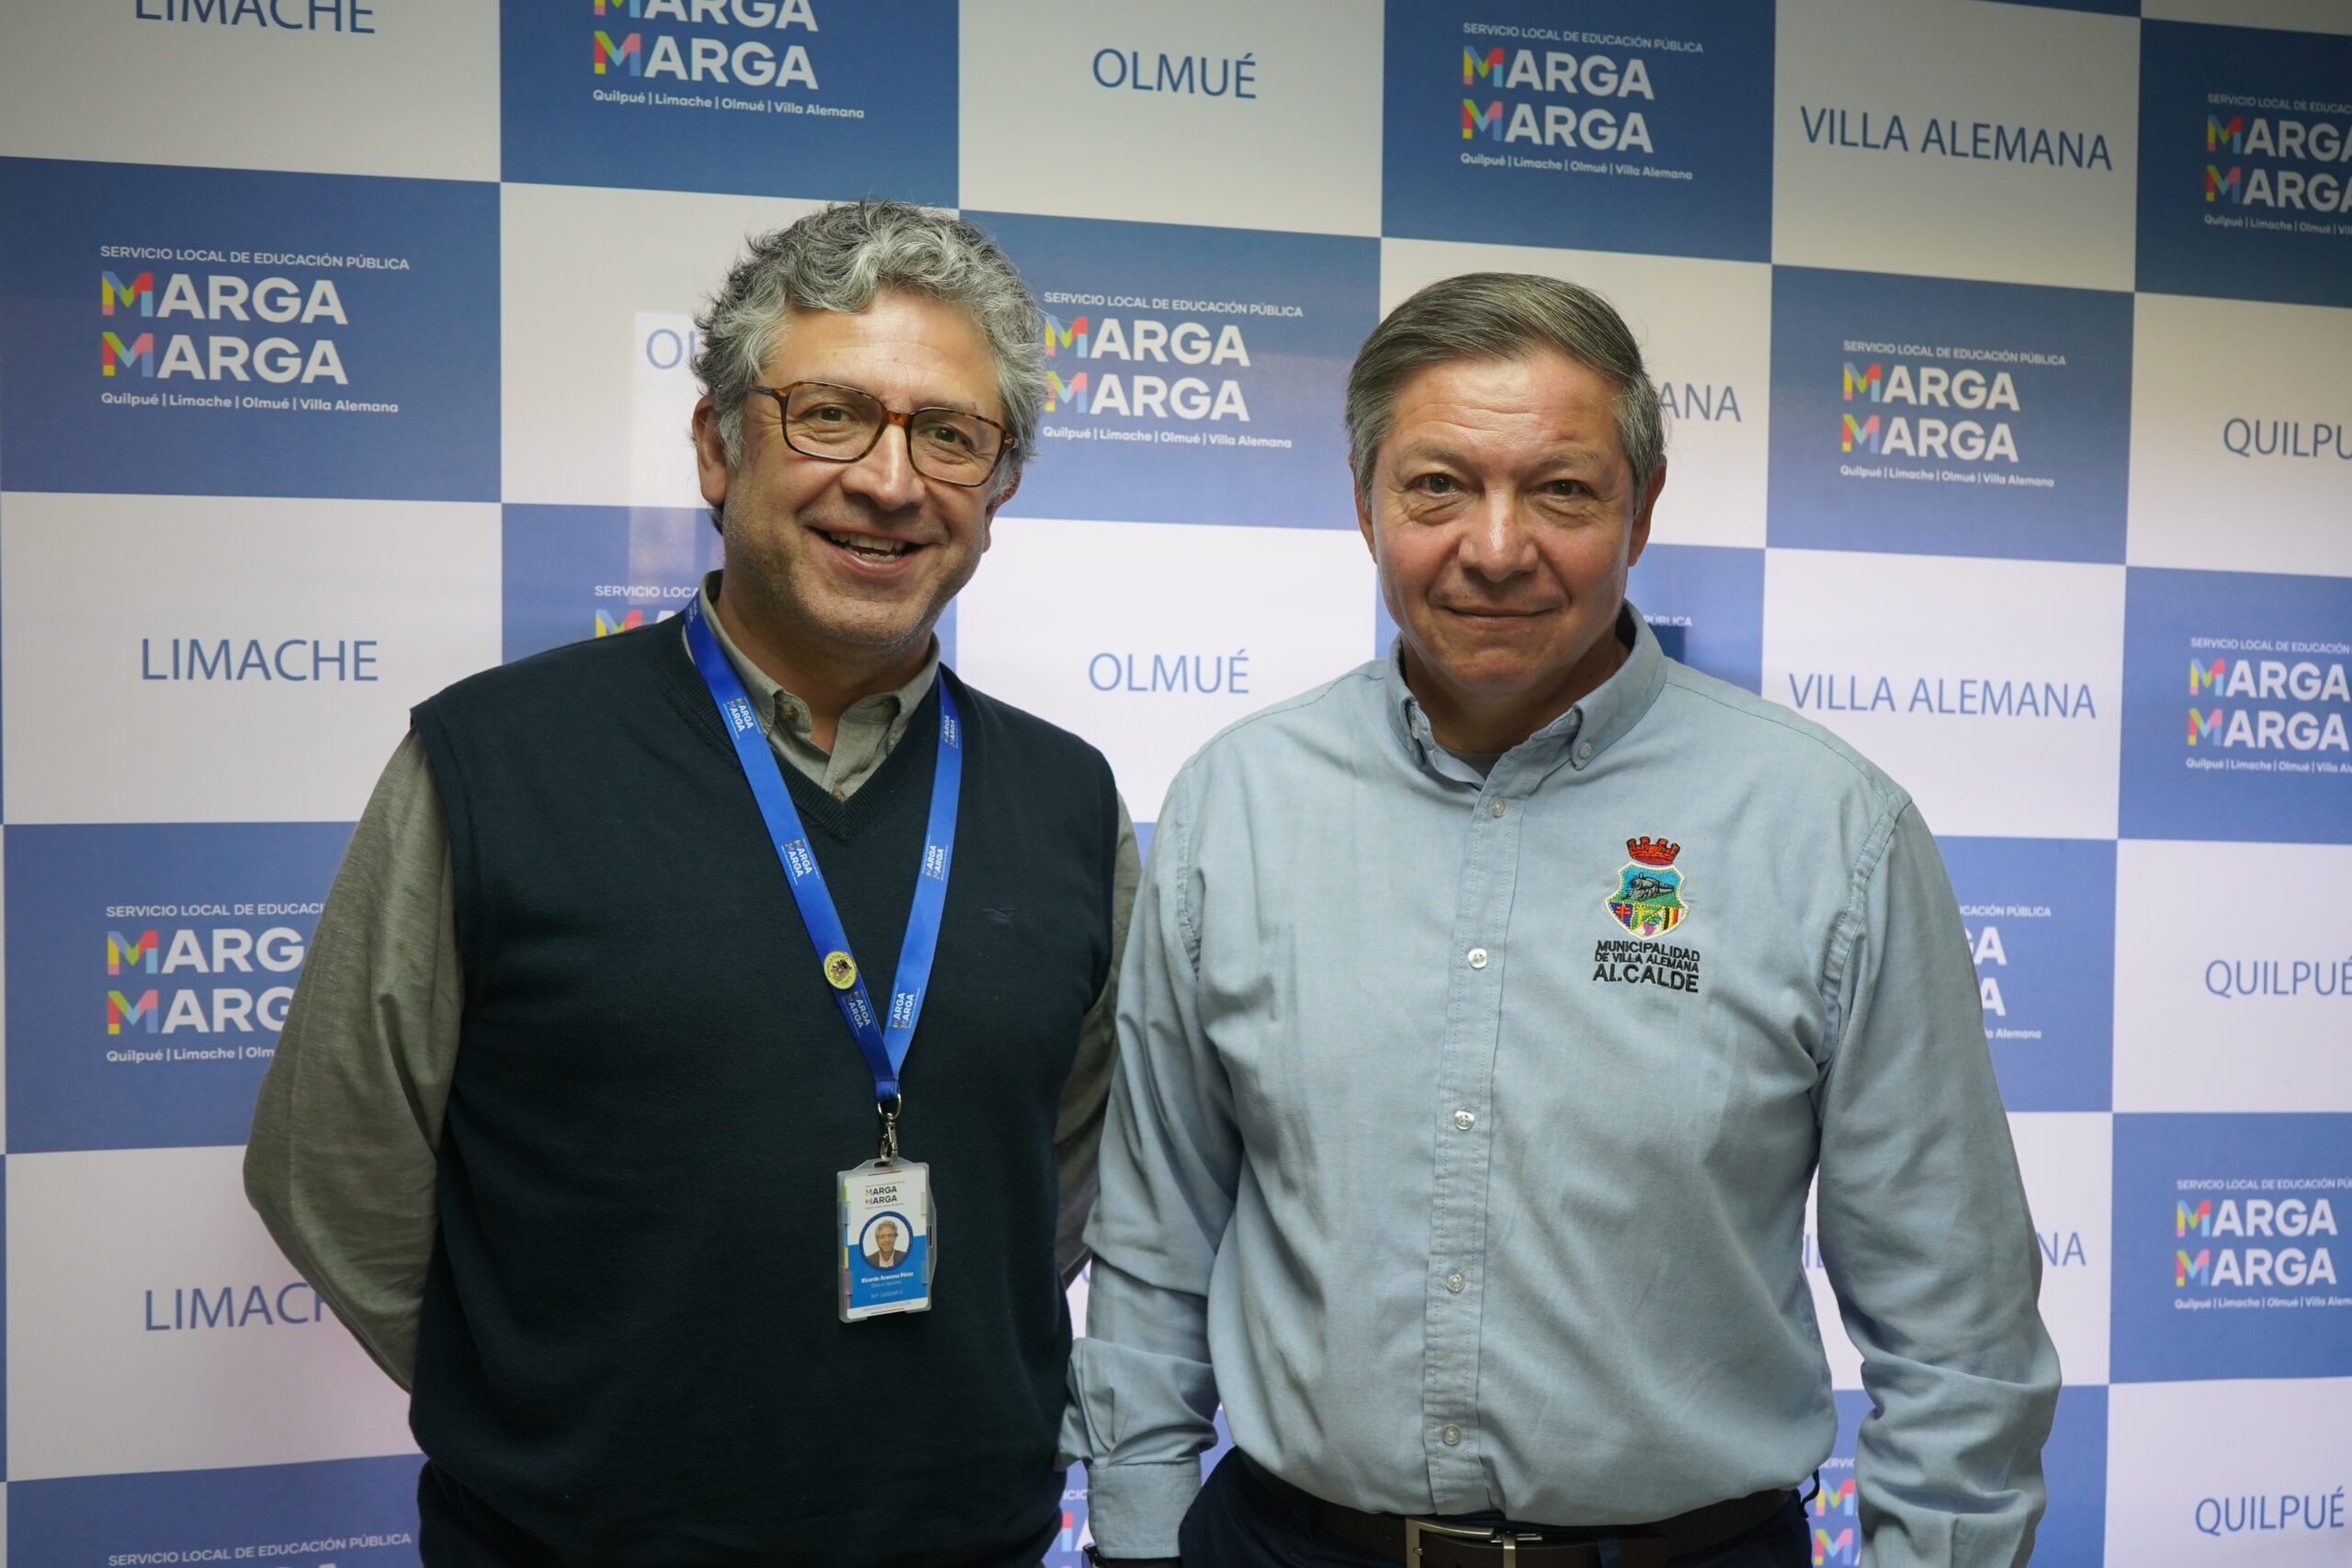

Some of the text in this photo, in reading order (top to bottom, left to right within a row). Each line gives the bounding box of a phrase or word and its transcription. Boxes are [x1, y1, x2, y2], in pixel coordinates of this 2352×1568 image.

[1464, 23, 1703, 52] SERVICIO LOCAL DE EDUCACIÓN PÚBLICA
[594, 31, 819, 89] MARGA
[1093, 49, 1256, 98] OLMUÉ
[1463, 46, 1655, 99] MARGA
[594, 90, 864, 118] Quilpué Limache Olmué Villa Alemana
[1463, 99, 1653, 152] MARGA
[1801, 107, 2111, 170] VILLA ALEMANA
[1461, 152, 1692, 180] Quilpué Limache Olmué Villa Alemana
[101, 246, 409, 269] SERVICIO LOCAL DE EDUCACIÓN PÚBLICA
[102, 271, 348, 324] MARGA
[1044, 292, 1303, 317] SERVICIO LOCAL DE EDUCACIÓN PÚBLICA
[103, 332, 348, 384] MARGA
[1045, 315, 1250, 367] MARGA
[1844, 341, 2065, 366] SERVICIO LOCAL DE EDUCACIÓN PÚBLICA
[102, 392, 398, 412] Quilpué Limache Olmué Villa Alemana
[1045, 371, 1250, 422] MARGA
[1843, 362, 2020, 412] MARGA
[1043, 426, 1292, 448] Quilpué Limache Olmué Villa Alemana
[1842, 414, 2018, 462] MARGA
[1840, 465, 2054, 487] Quilpué Limache Olmué Villa Alemana
[595, 585, 660, 597] SERVICIO
[142, 638, 378, 681] LIMACHE
[2191, 637, 2238, 649] SERVICIO
[2241, 639, 2273, 650] LOCAL
[2276, 641, 2289, 651] DE
[2291, 642, 2349, 654] EDUCACIÓN
[1089, 649, 1249, 694] OLMUÉ
[2189, 659, 2351, 702] MARGA
[1788, 673, 2096, 718] VILLA ALEMANA
[2188, 708, 2349, 751] MARGA
[2186, 758, 2224, 770] Quilpué
[2231, 760, 2272, 771] Limache
[2278, 761, 2310, 772] Olmué
[2317, 762, 2337, 773] Villa
[794, 840, 812, 874] MARGA
[107, 903, 323, 917] SERVICIO LOCAL DE EDUCACI
[2007, 904, 2052, 917] PÚBLICA
[107, 927, 304, 975] MARG
[1595, 951, 1699, 973] DE VILLA ALEMANA
[1597, 940, 1700, 962] MUNICIPALIDAD
[1592, 964, 1699, 993] ALCALDE
[107, 987, 294, 1034] MARG
[892, 992, 906, 1028] MARGA
[900, 994, 915, 1029] MARGA
[1996, 1029, 2041, 1039] Alemana
[107, 1047, 275, 1064] Quilpué Limache Olm
[865, 1187, 897, 1196] MARGA
[865, 1196, 897, 1205] MARGA
[2177, 1179, 2224, 1190] SERVICIO
[2226, 1179, 2259, 1190] LOCAL
[2261, 1179, 2275, 1190] DE
[2277, 1178, 2335, 1190] EDUCACIÓN
[2177, 1199, 2337, 1236] MARGA
[2176, 1248, 2336, 1286] MARGA
[145, 1282, 324, 1331] LIMAC
[2196, 1486, 2344, 1536] QUILPUÉ
[108, 1533, 411, 1566] SERVICIO LOCAL DE EDUCACIÓN PÚBLICA
